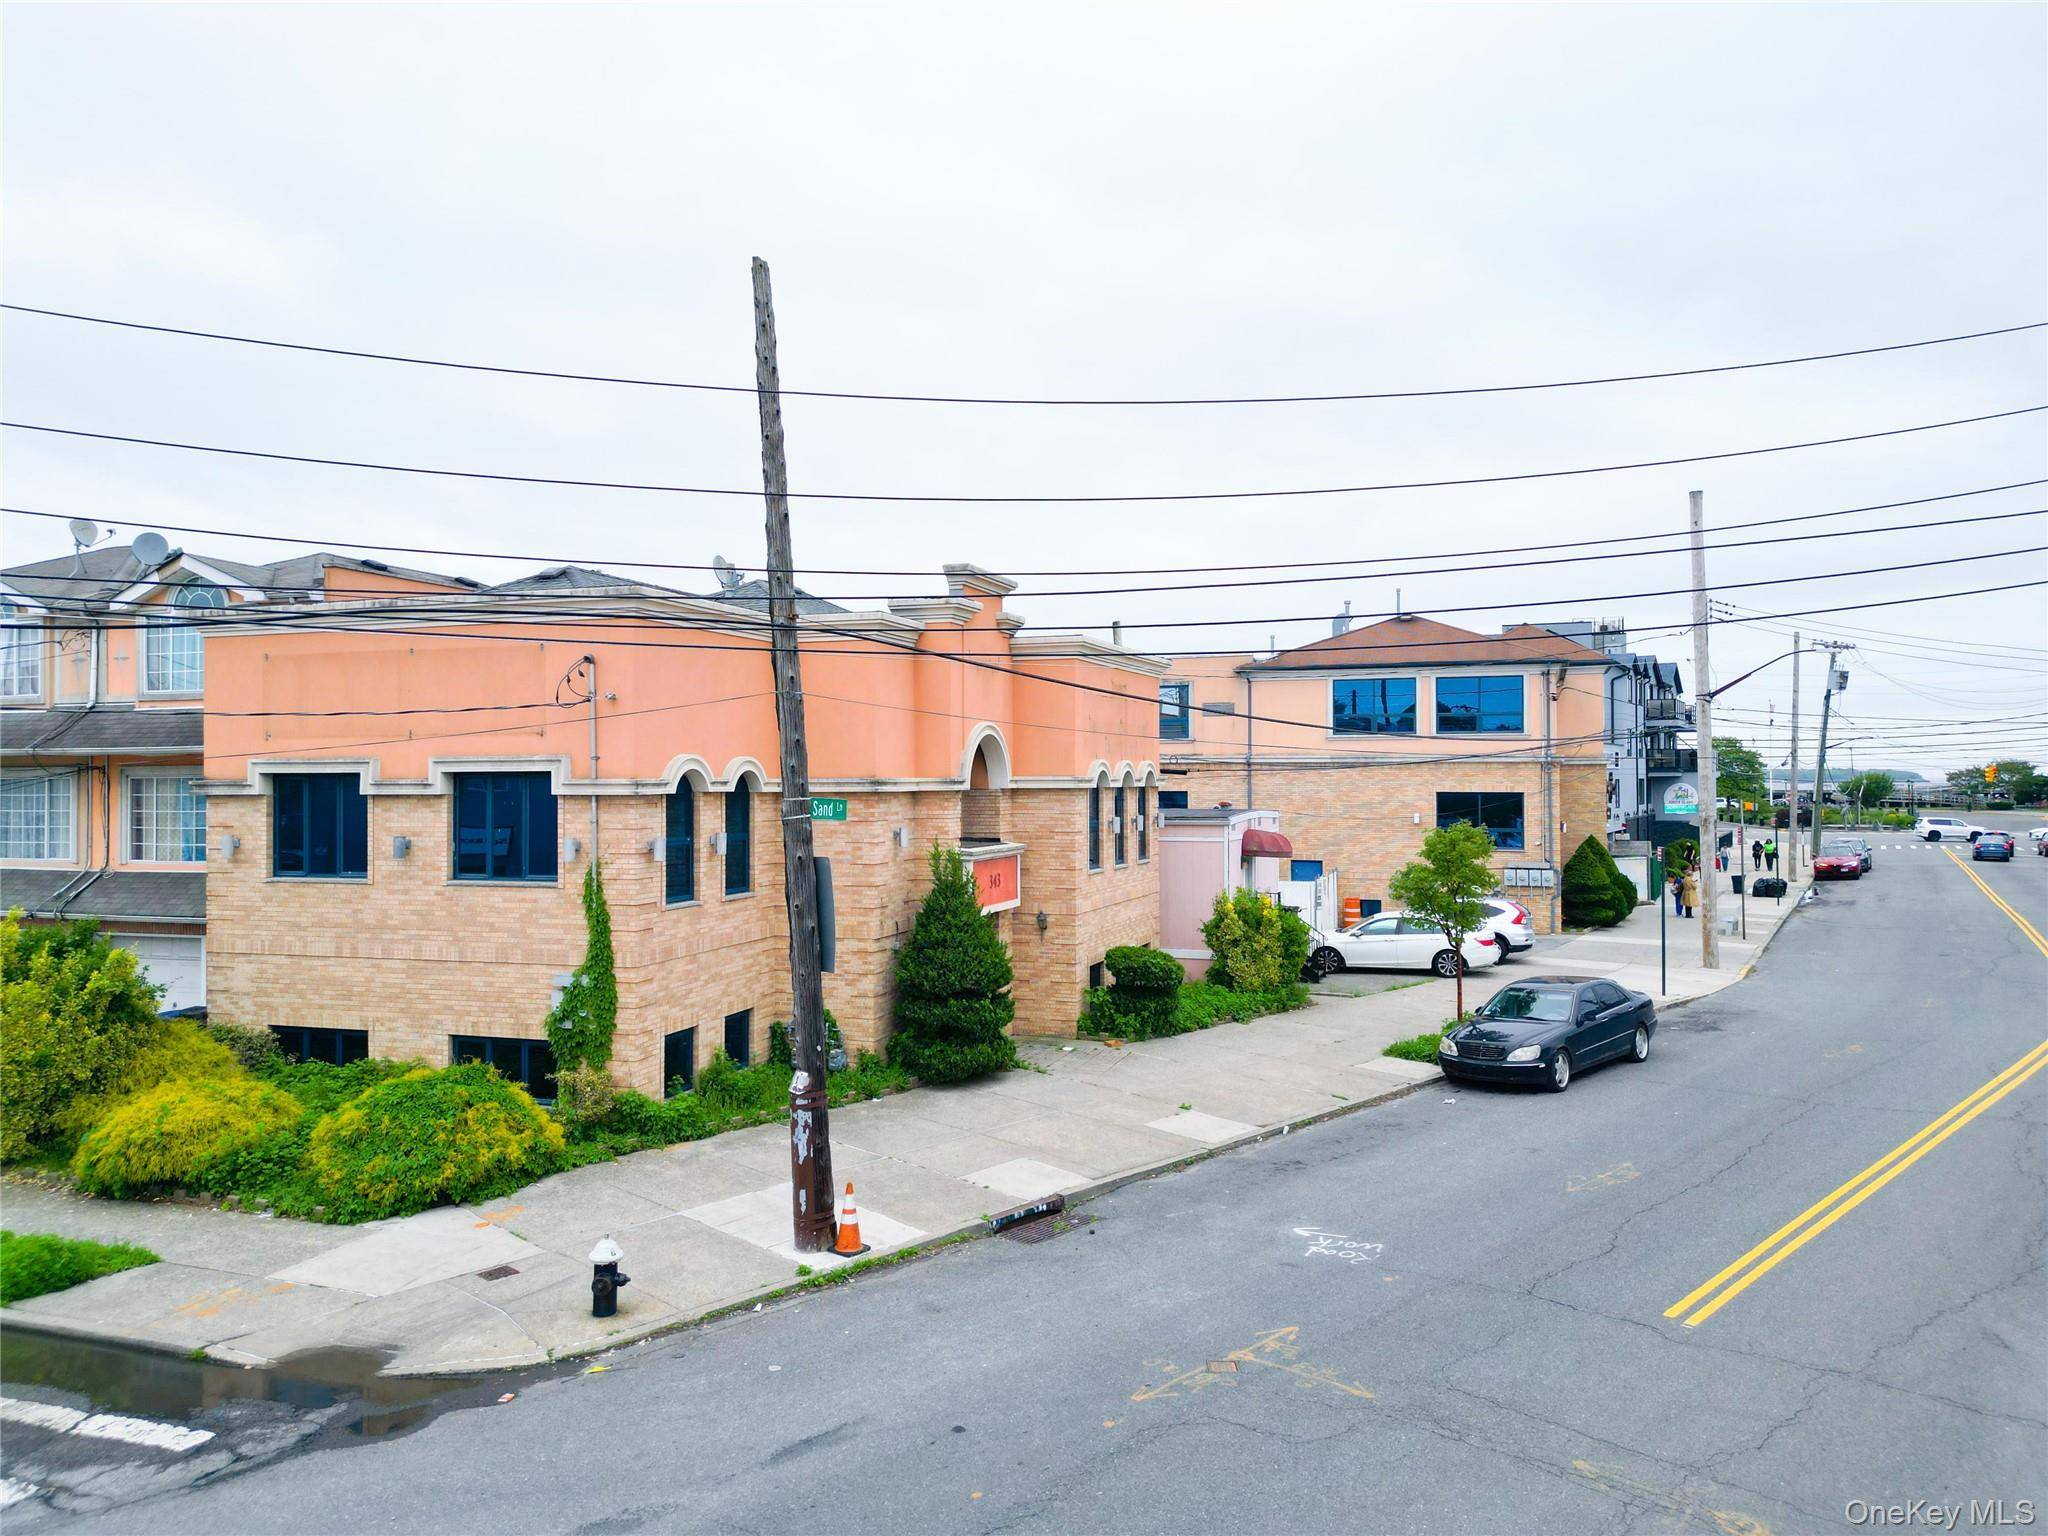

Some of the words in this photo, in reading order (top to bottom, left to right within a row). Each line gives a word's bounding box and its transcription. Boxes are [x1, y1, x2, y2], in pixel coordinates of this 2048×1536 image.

[812, 800, 834, 816] Sand
[836, 802, 843, 812] Ln
[989, 873, 1001, 889] 343
